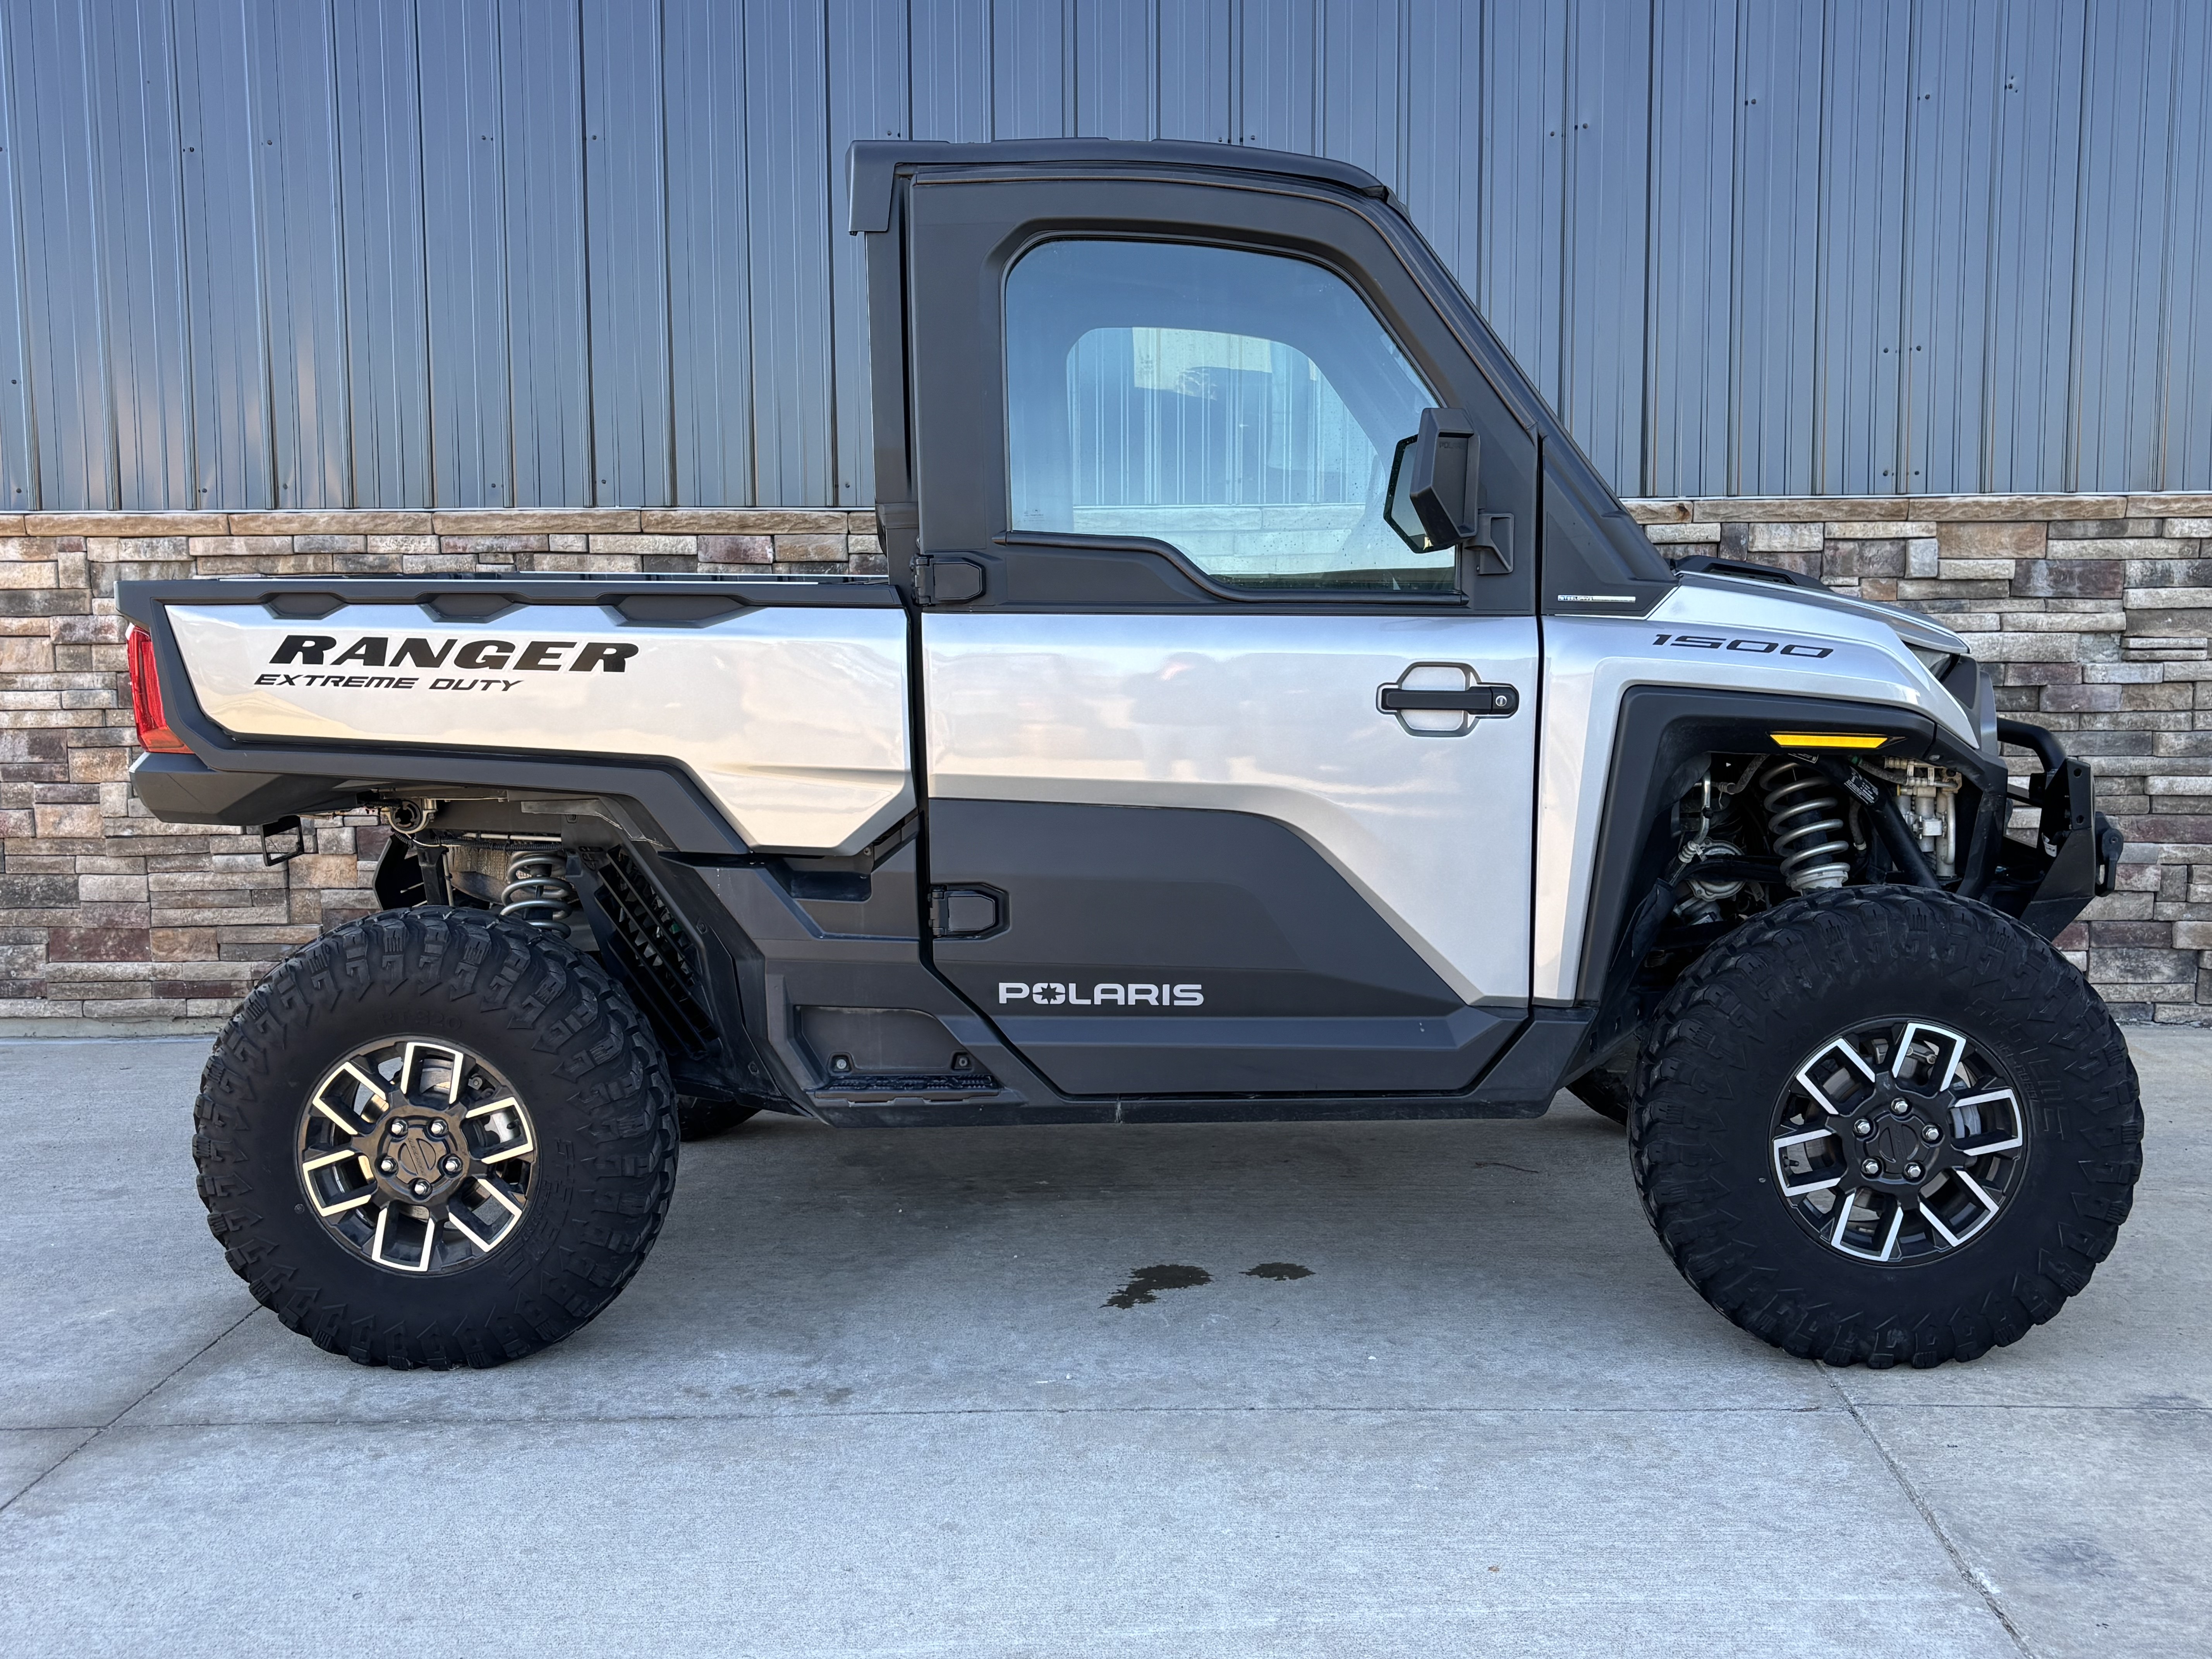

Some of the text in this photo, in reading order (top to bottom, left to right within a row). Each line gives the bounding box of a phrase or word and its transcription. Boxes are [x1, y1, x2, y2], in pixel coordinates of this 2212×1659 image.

[268, 635, 639, 673] RANGER
[1652, 634, 1834, 659] 1500
[254, 673, 522, 692] EXTREME DUTY
[998, 982, 1204, 1006] POLARIS
